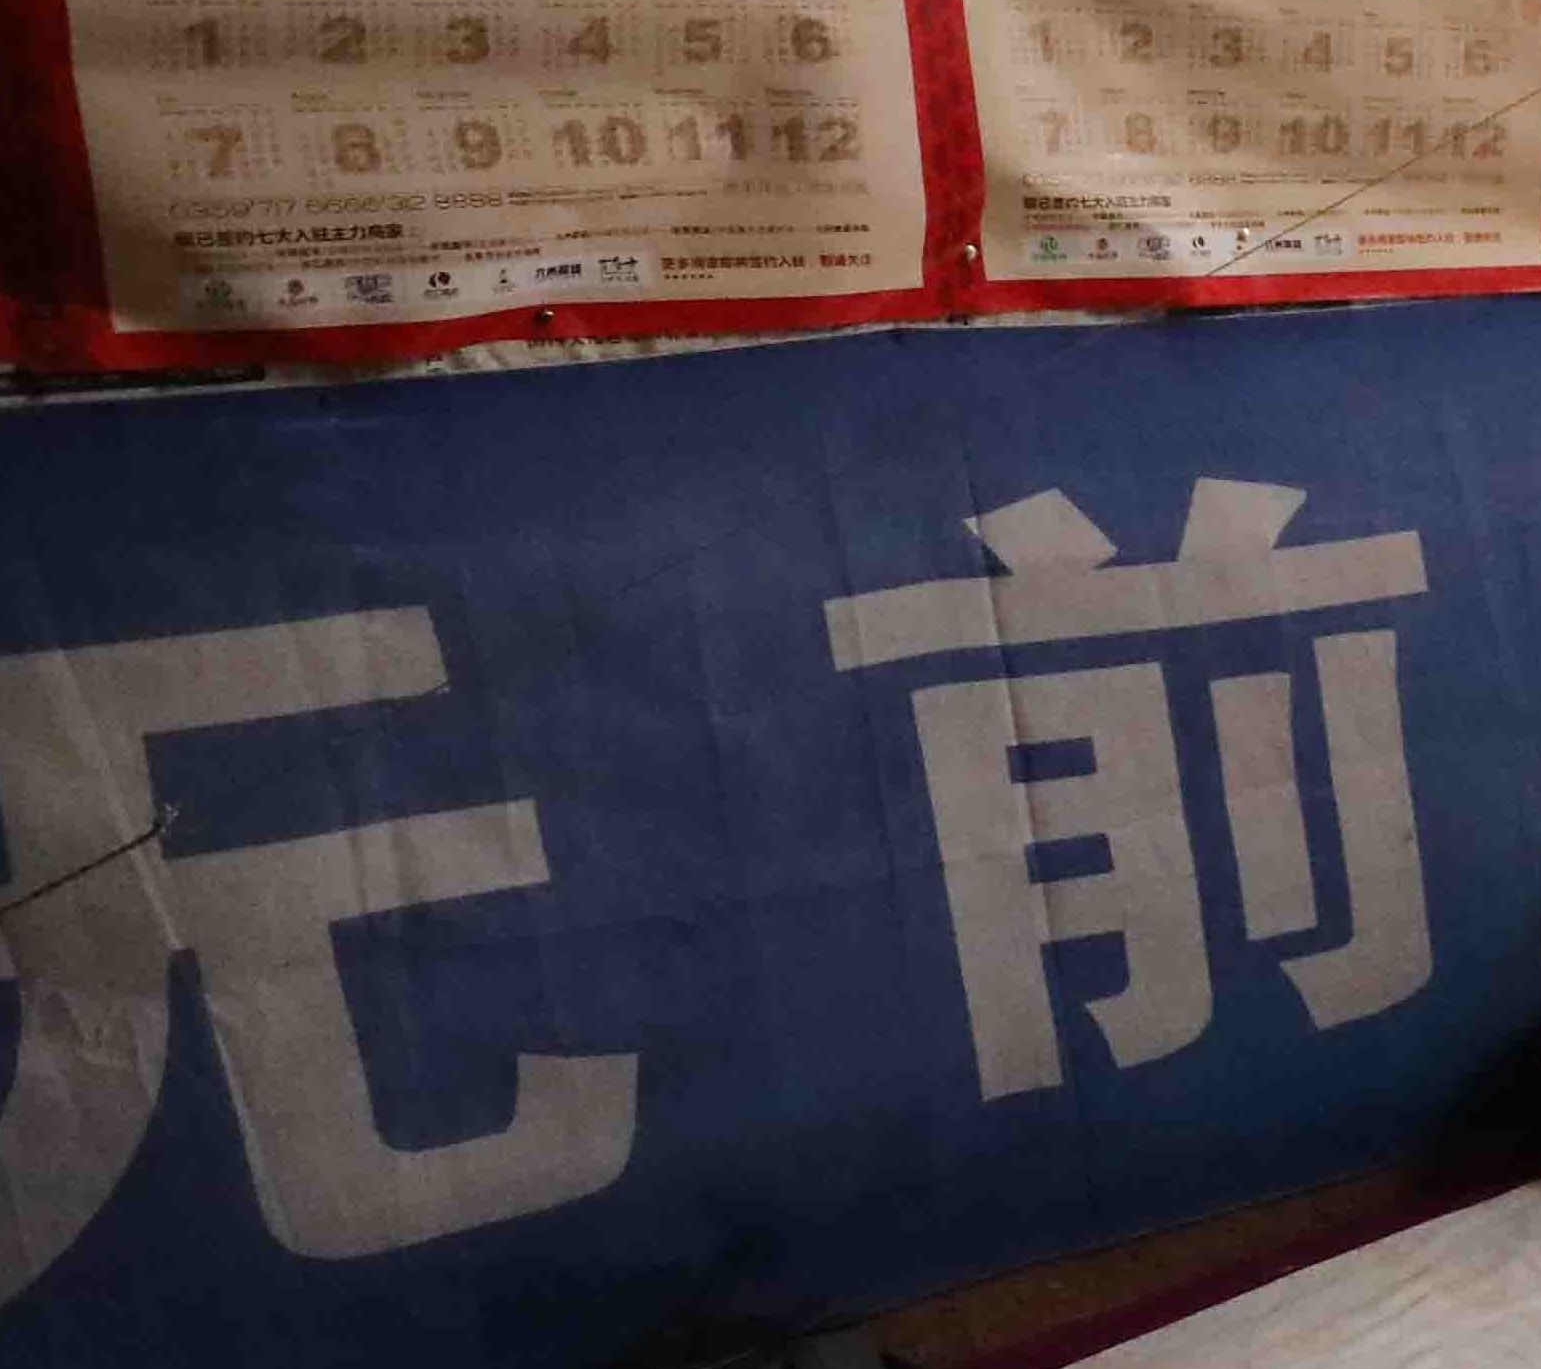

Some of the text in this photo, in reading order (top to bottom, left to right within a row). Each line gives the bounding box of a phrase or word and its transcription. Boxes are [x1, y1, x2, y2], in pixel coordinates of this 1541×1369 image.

[184, 16, 830, 64] 1 2 3 4 5 6
[1303, 30, 1332, 73] 4
[188, 113, 859, 177] 7 8 9 10 11 12
[1125, 112, 1156, 154] 8
[1279, 114, 1351, 156] 10
[1365, 114, 1425, 158] 11
